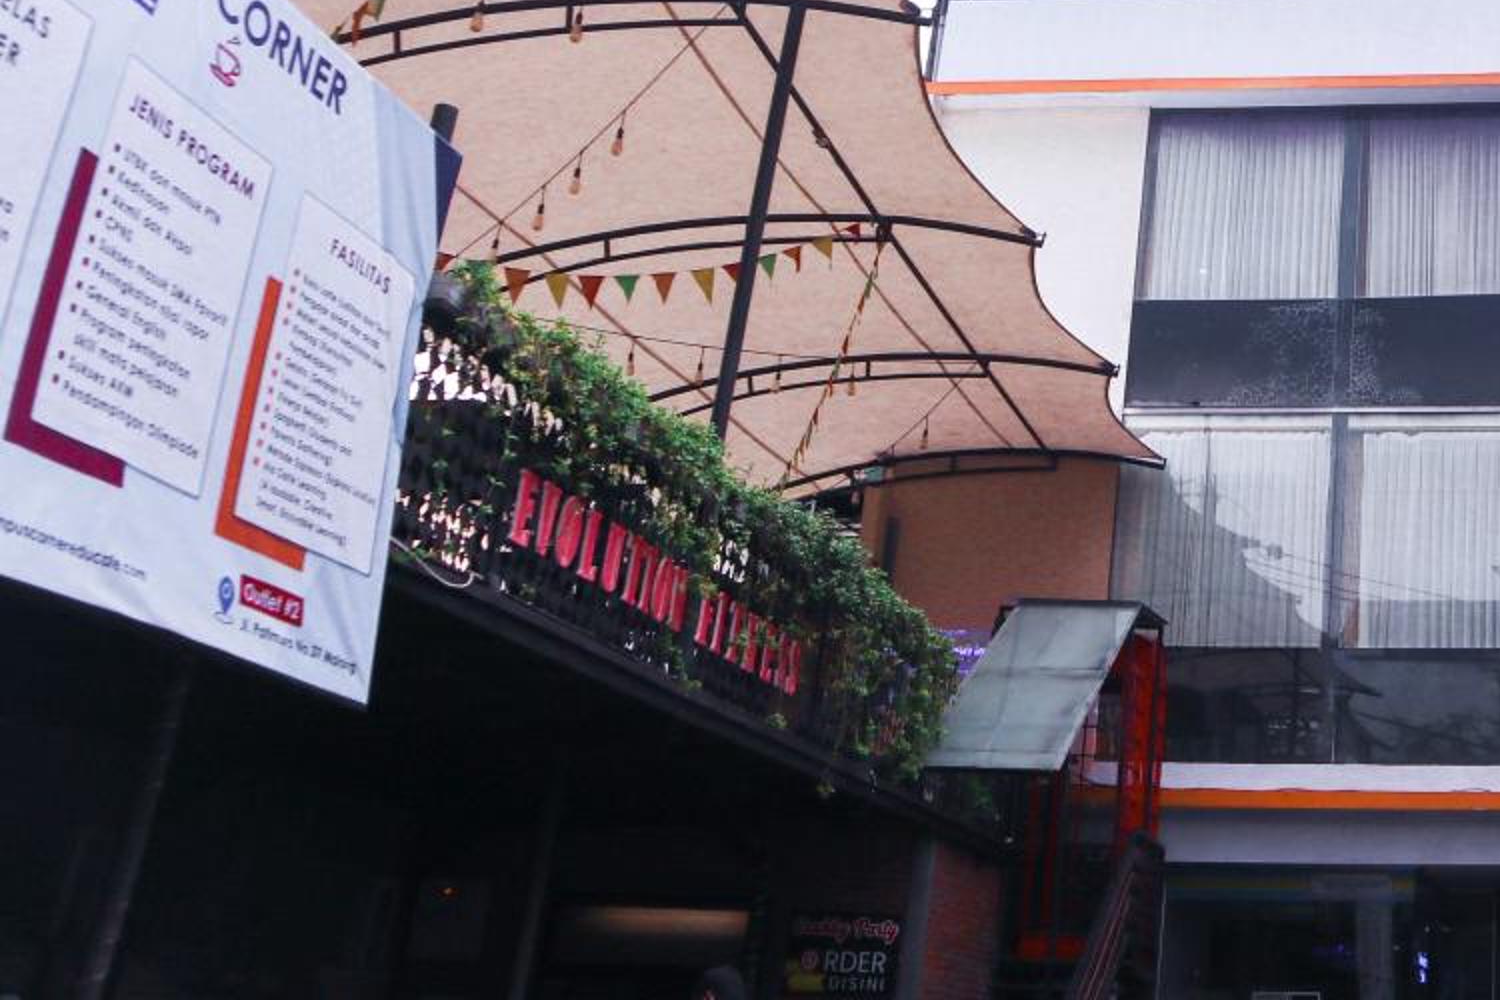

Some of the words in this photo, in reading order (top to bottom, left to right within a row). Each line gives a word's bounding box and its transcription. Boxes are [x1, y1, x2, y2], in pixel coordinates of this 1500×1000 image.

[128, 93, 174, 140] JENIS
[176, 128, 255, 201] PROGRAM
[329, 238, 392, 296] FASILITAS
[508, 468, 690, 633] EVOLUTION
[241, 579, 282, 614] Outlet
